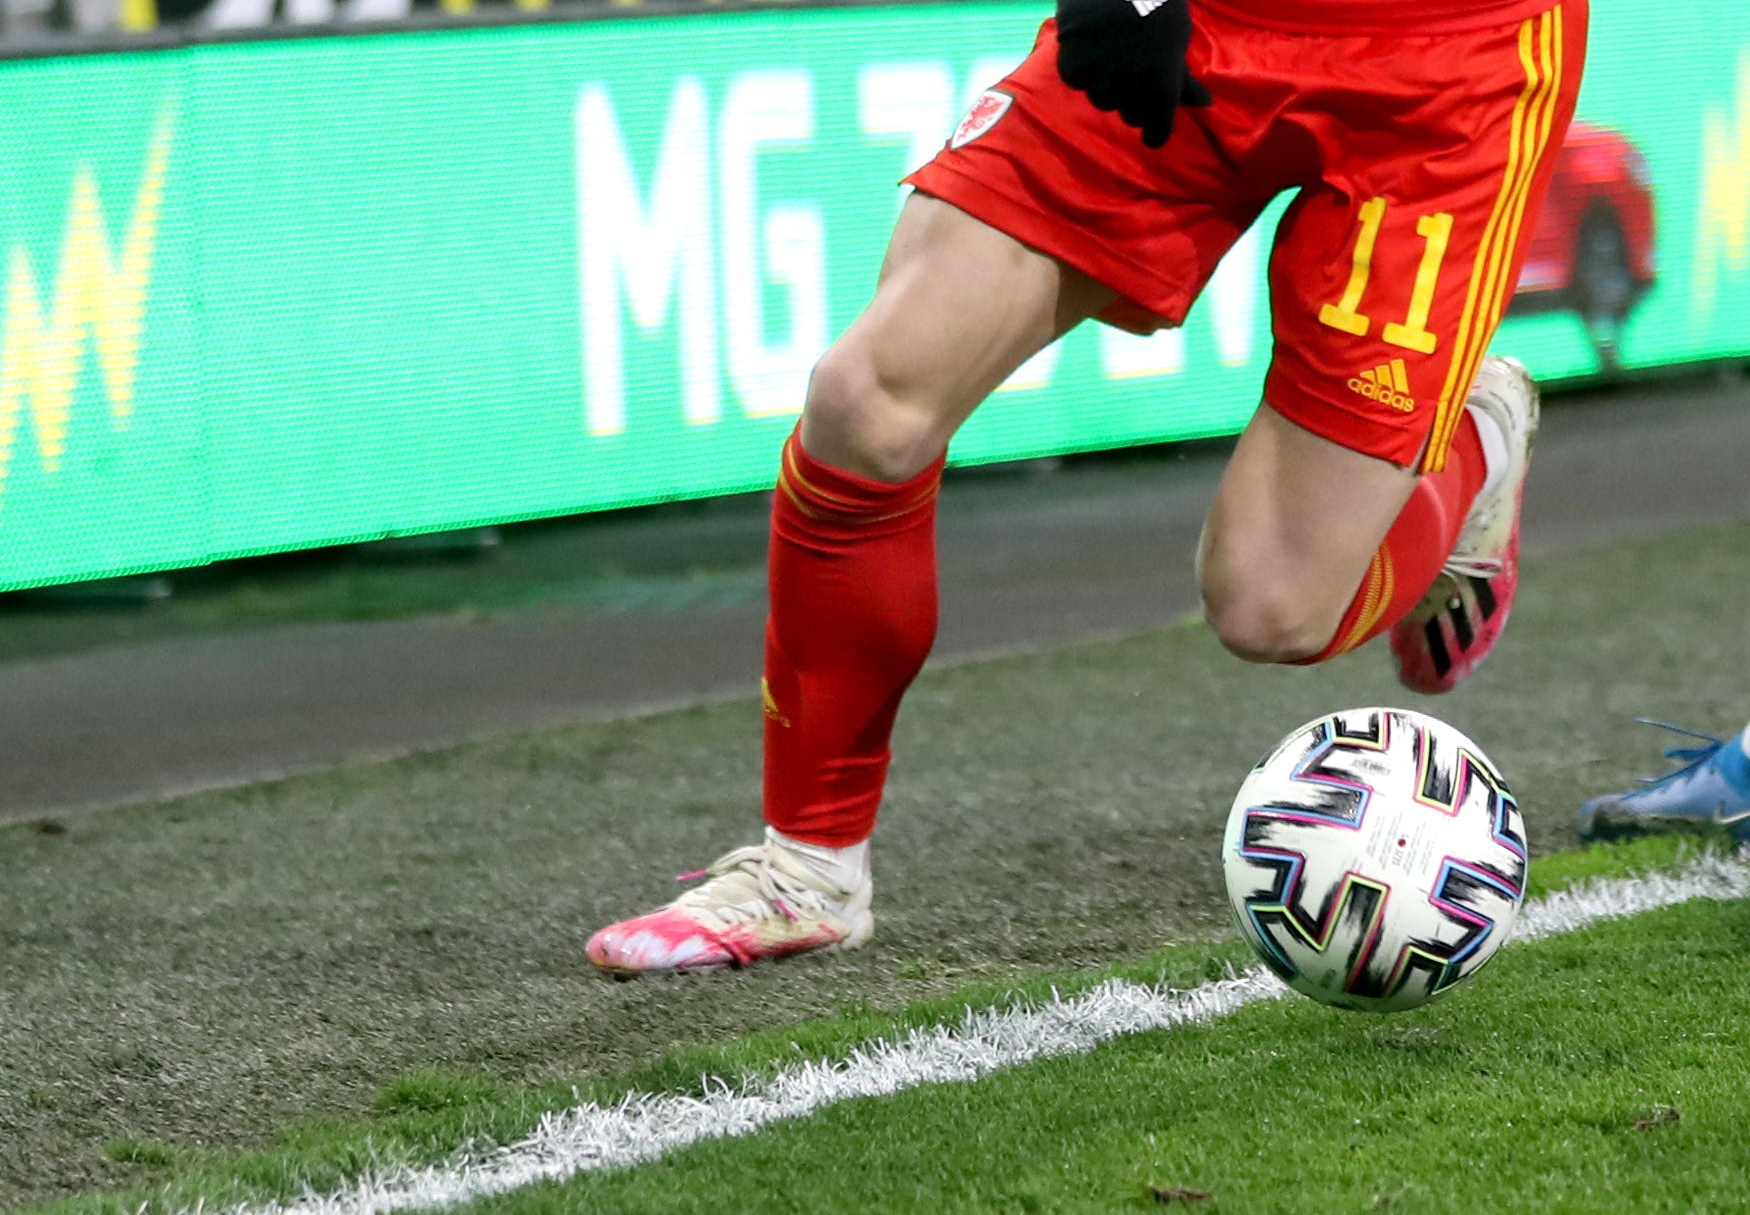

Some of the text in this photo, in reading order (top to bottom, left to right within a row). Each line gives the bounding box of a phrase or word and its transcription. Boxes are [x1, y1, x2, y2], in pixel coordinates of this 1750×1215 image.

[575, 65, 830, 437] MG
[1318, 196, 1454, 354] 11
[1347, 377, 1415, 413] adidas
